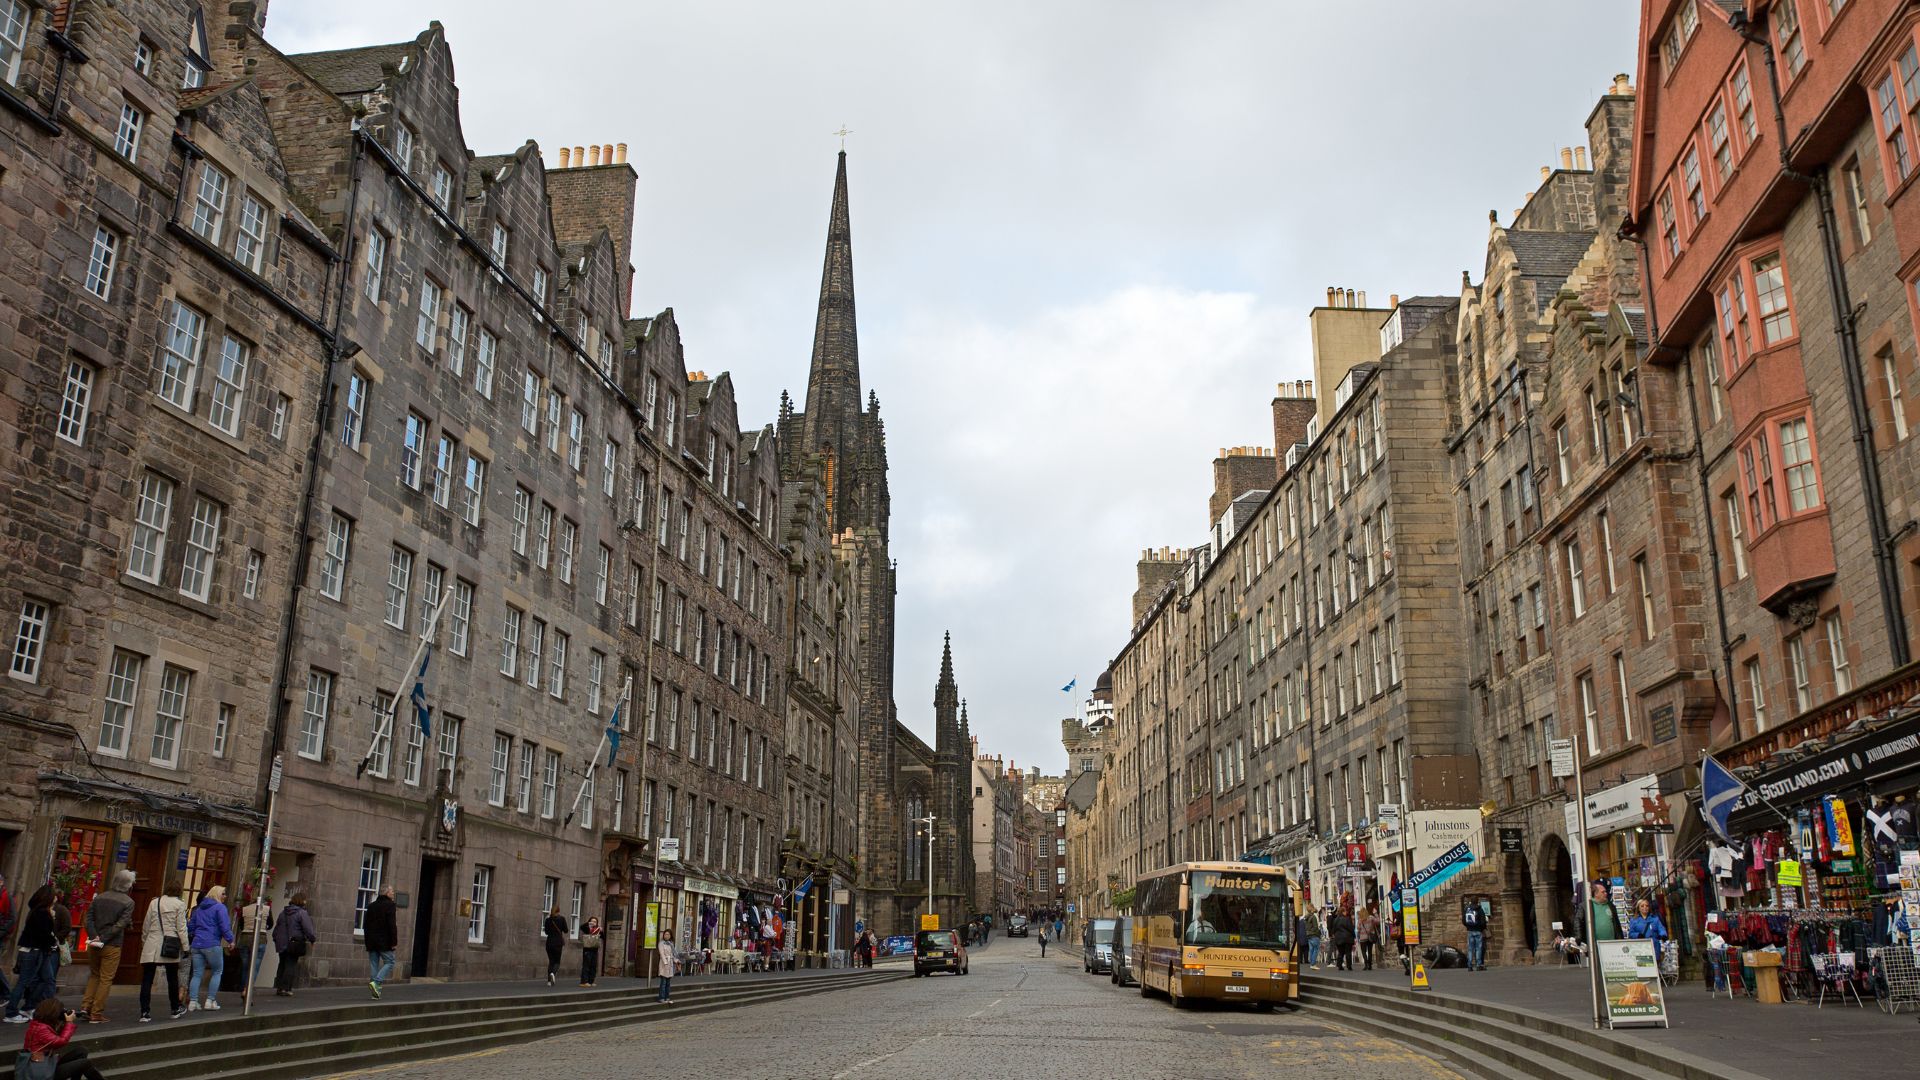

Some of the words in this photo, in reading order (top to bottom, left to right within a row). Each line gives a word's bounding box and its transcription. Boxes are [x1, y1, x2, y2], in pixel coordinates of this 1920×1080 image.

[1865, 746, 1884, 763] JOHN
[1882, 734, 1920, 757] MORRISON
[1759, 757, 1850, 801] SCOTLAND.COM
[1424, 820, 1470, 832] Johnstons
[1398, 864, 1438, 889] STORIC
[1438, 843, 1468, 869] HOUSE
[1204, 875, 1271, 890] Hunter's
[1238, 954, 1272, 963] COACHES
